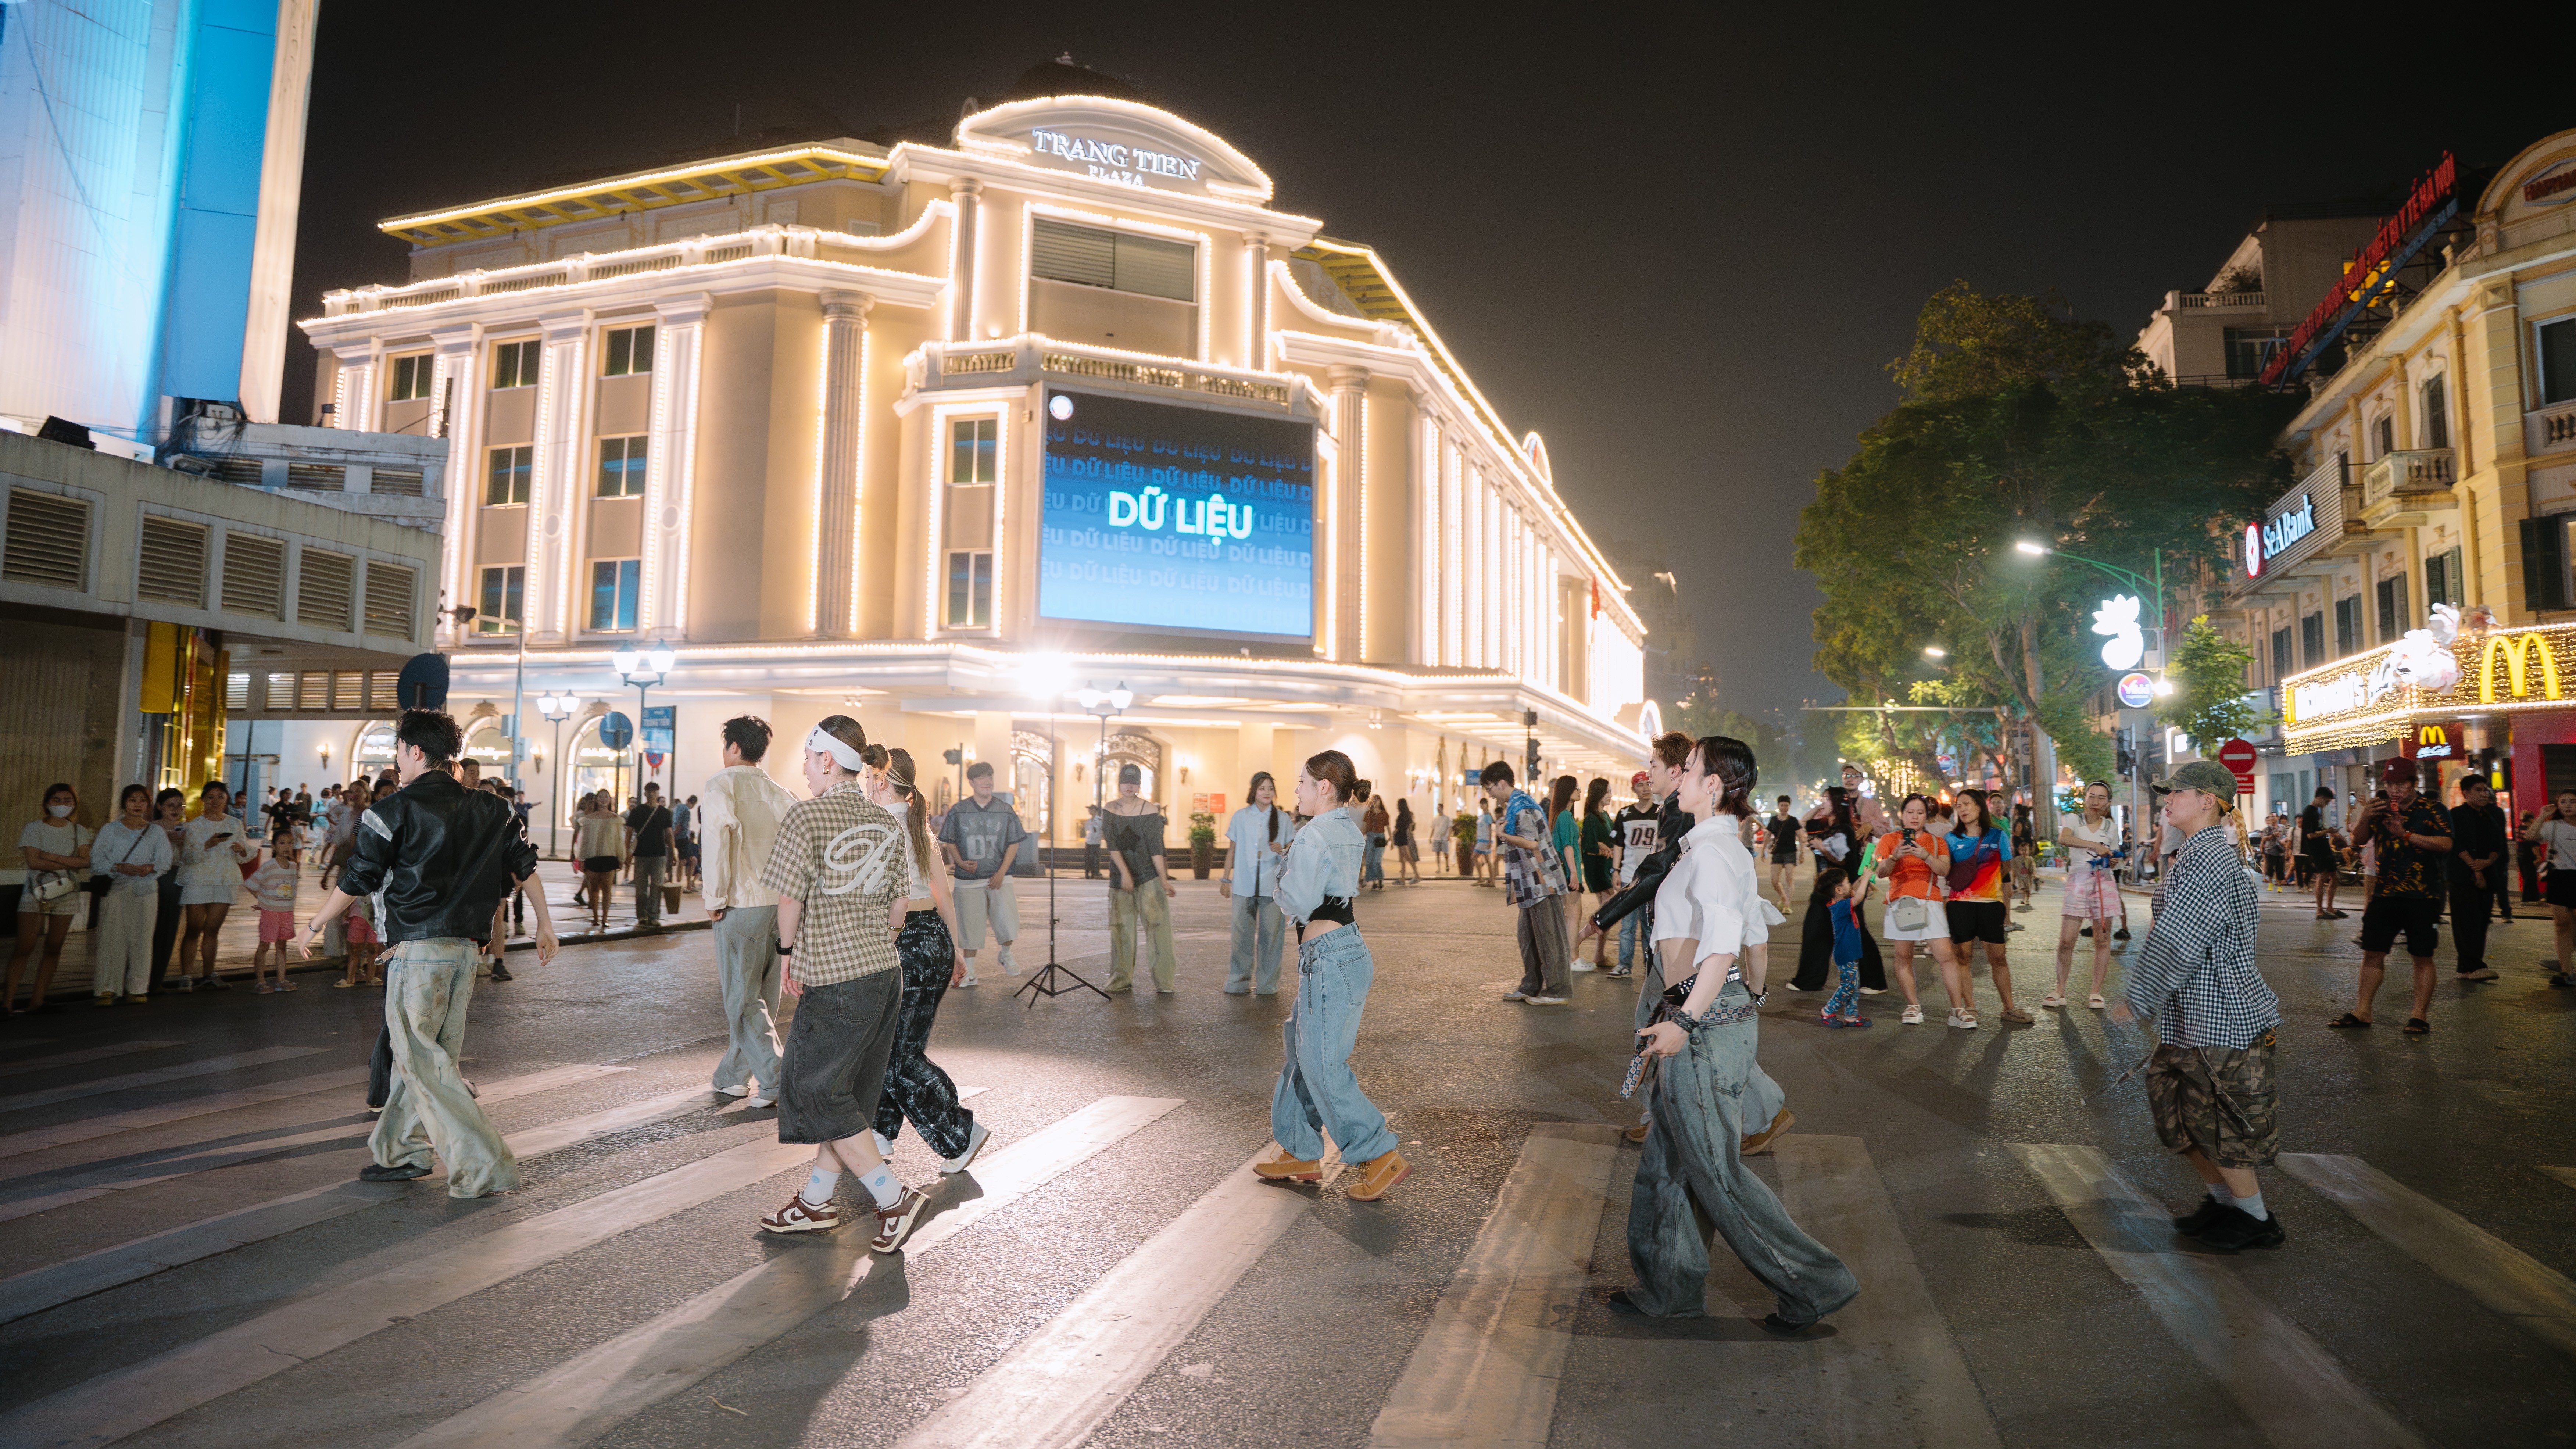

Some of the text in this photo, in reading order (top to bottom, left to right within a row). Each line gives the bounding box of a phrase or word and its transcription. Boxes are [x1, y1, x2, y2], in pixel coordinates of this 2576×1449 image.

[1032, 129, 1201, 180] TRANG TIEN
[1088, 164, 1145, 186] PLAZA
[1072, 457, 1102, 477] DỮ
[1105, 461, 1144, 486] LIỆU
[1152, 466, 1180, 486] DỮ
[1183, 469, 1221, 495] LIỆU
[1230, 475, 1257, 495] DỮ
[1260, 479, 1296, 503] LIỆU
[1072, 492, 1102, 513] DỮ
[1109, 485, 1169, 531] DỮ
[1176, 493, 1253, 546] LIỆU
[2263, 494, 2314, 559] SeABank
[1070, 527, 1100, 549] DỮ
[1103, 531, 1142, 557] LIỆU
[1150, 535, 1179, 556] DỮ
[1181, 539, 1220, 563] LIỆU
[1228, 543, 1256, 563] DỮ
[1259, 545, 1295, 570] LIỆU
[967, 834, 998, 859] 07
[1631, 827, 1655, 847] 09
